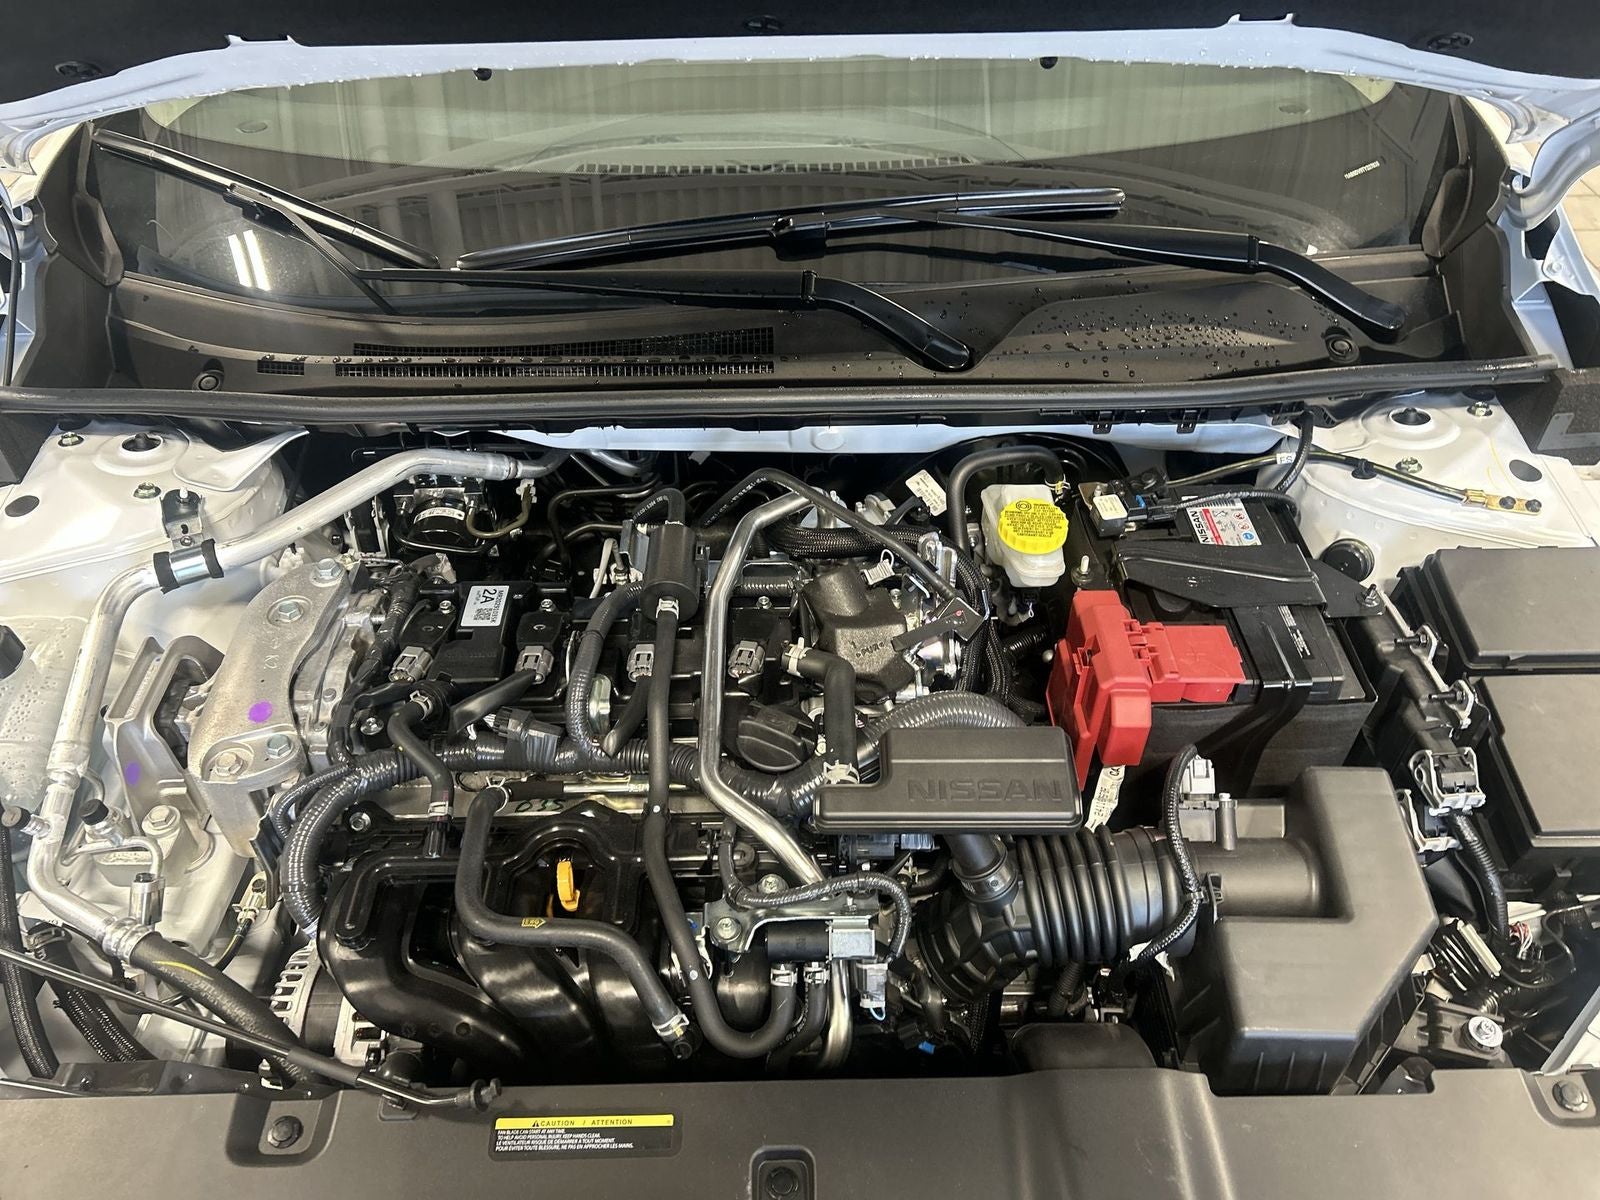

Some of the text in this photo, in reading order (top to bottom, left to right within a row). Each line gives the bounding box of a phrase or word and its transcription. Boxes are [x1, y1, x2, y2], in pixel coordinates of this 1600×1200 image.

[1190, 510, 1210, 543] NISSAN
[480, 588, 497, 604] 2A
[907, 778, 1062, 802] NISSAN
